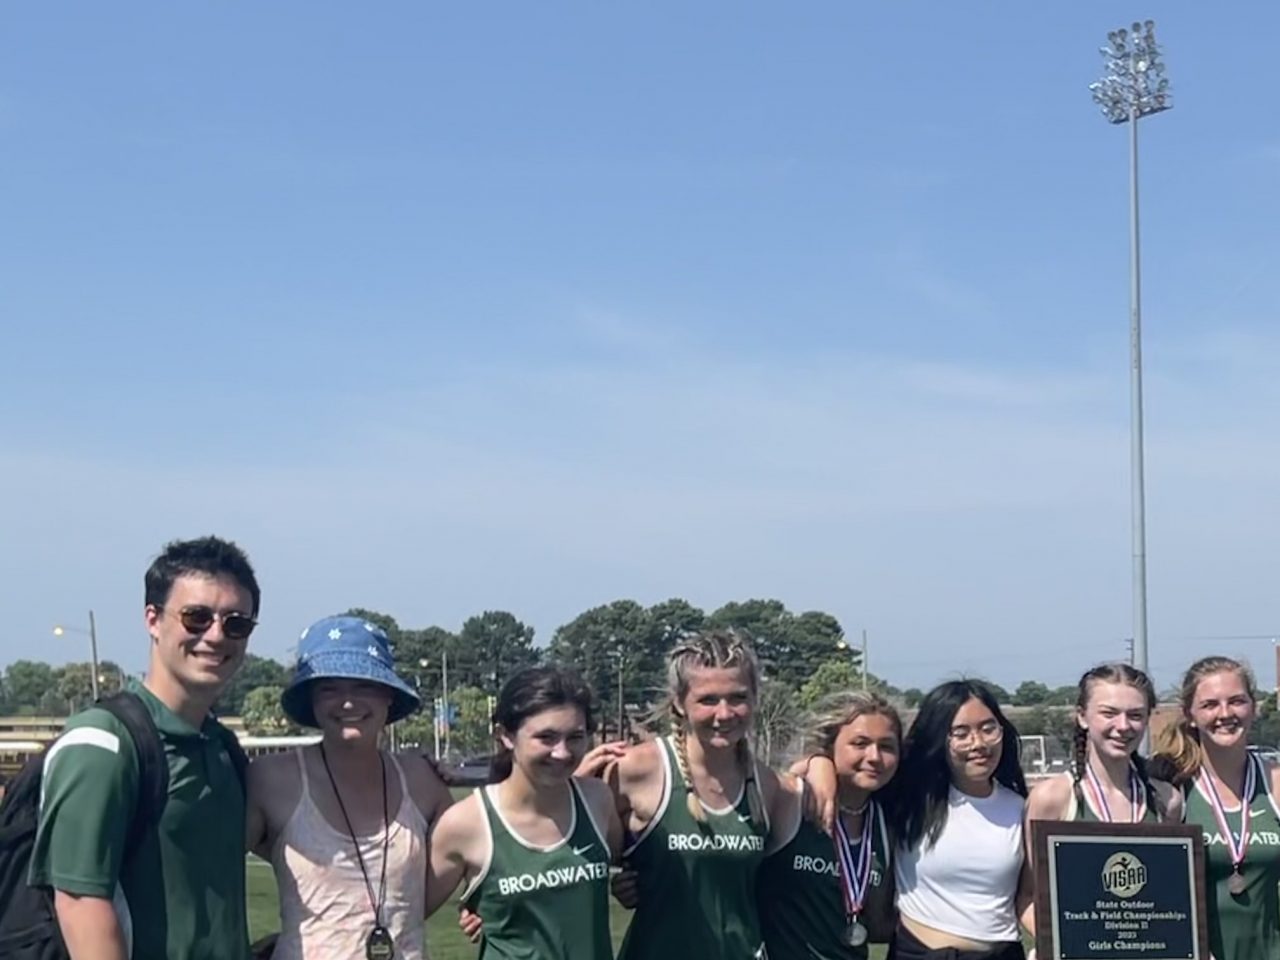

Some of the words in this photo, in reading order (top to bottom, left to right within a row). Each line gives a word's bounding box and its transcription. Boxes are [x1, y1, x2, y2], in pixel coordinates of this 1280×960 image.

[1103, 866, 1145, 890] VISAA
[1096, 901, 1118, 909] State
[1120, 901, 1154, 909] Outdoor
[1064, 911, 1089, 920] Track
[1091, 911, 1099, 920] &
[1100, 911, 1121, 920] Field
[1123, 911, 1187, 921] Championships
[1104, 921, 1139, 929] Division
[1088, 941, 1112, 950] Girls
[1113, 941, 1167, 952] Champions
